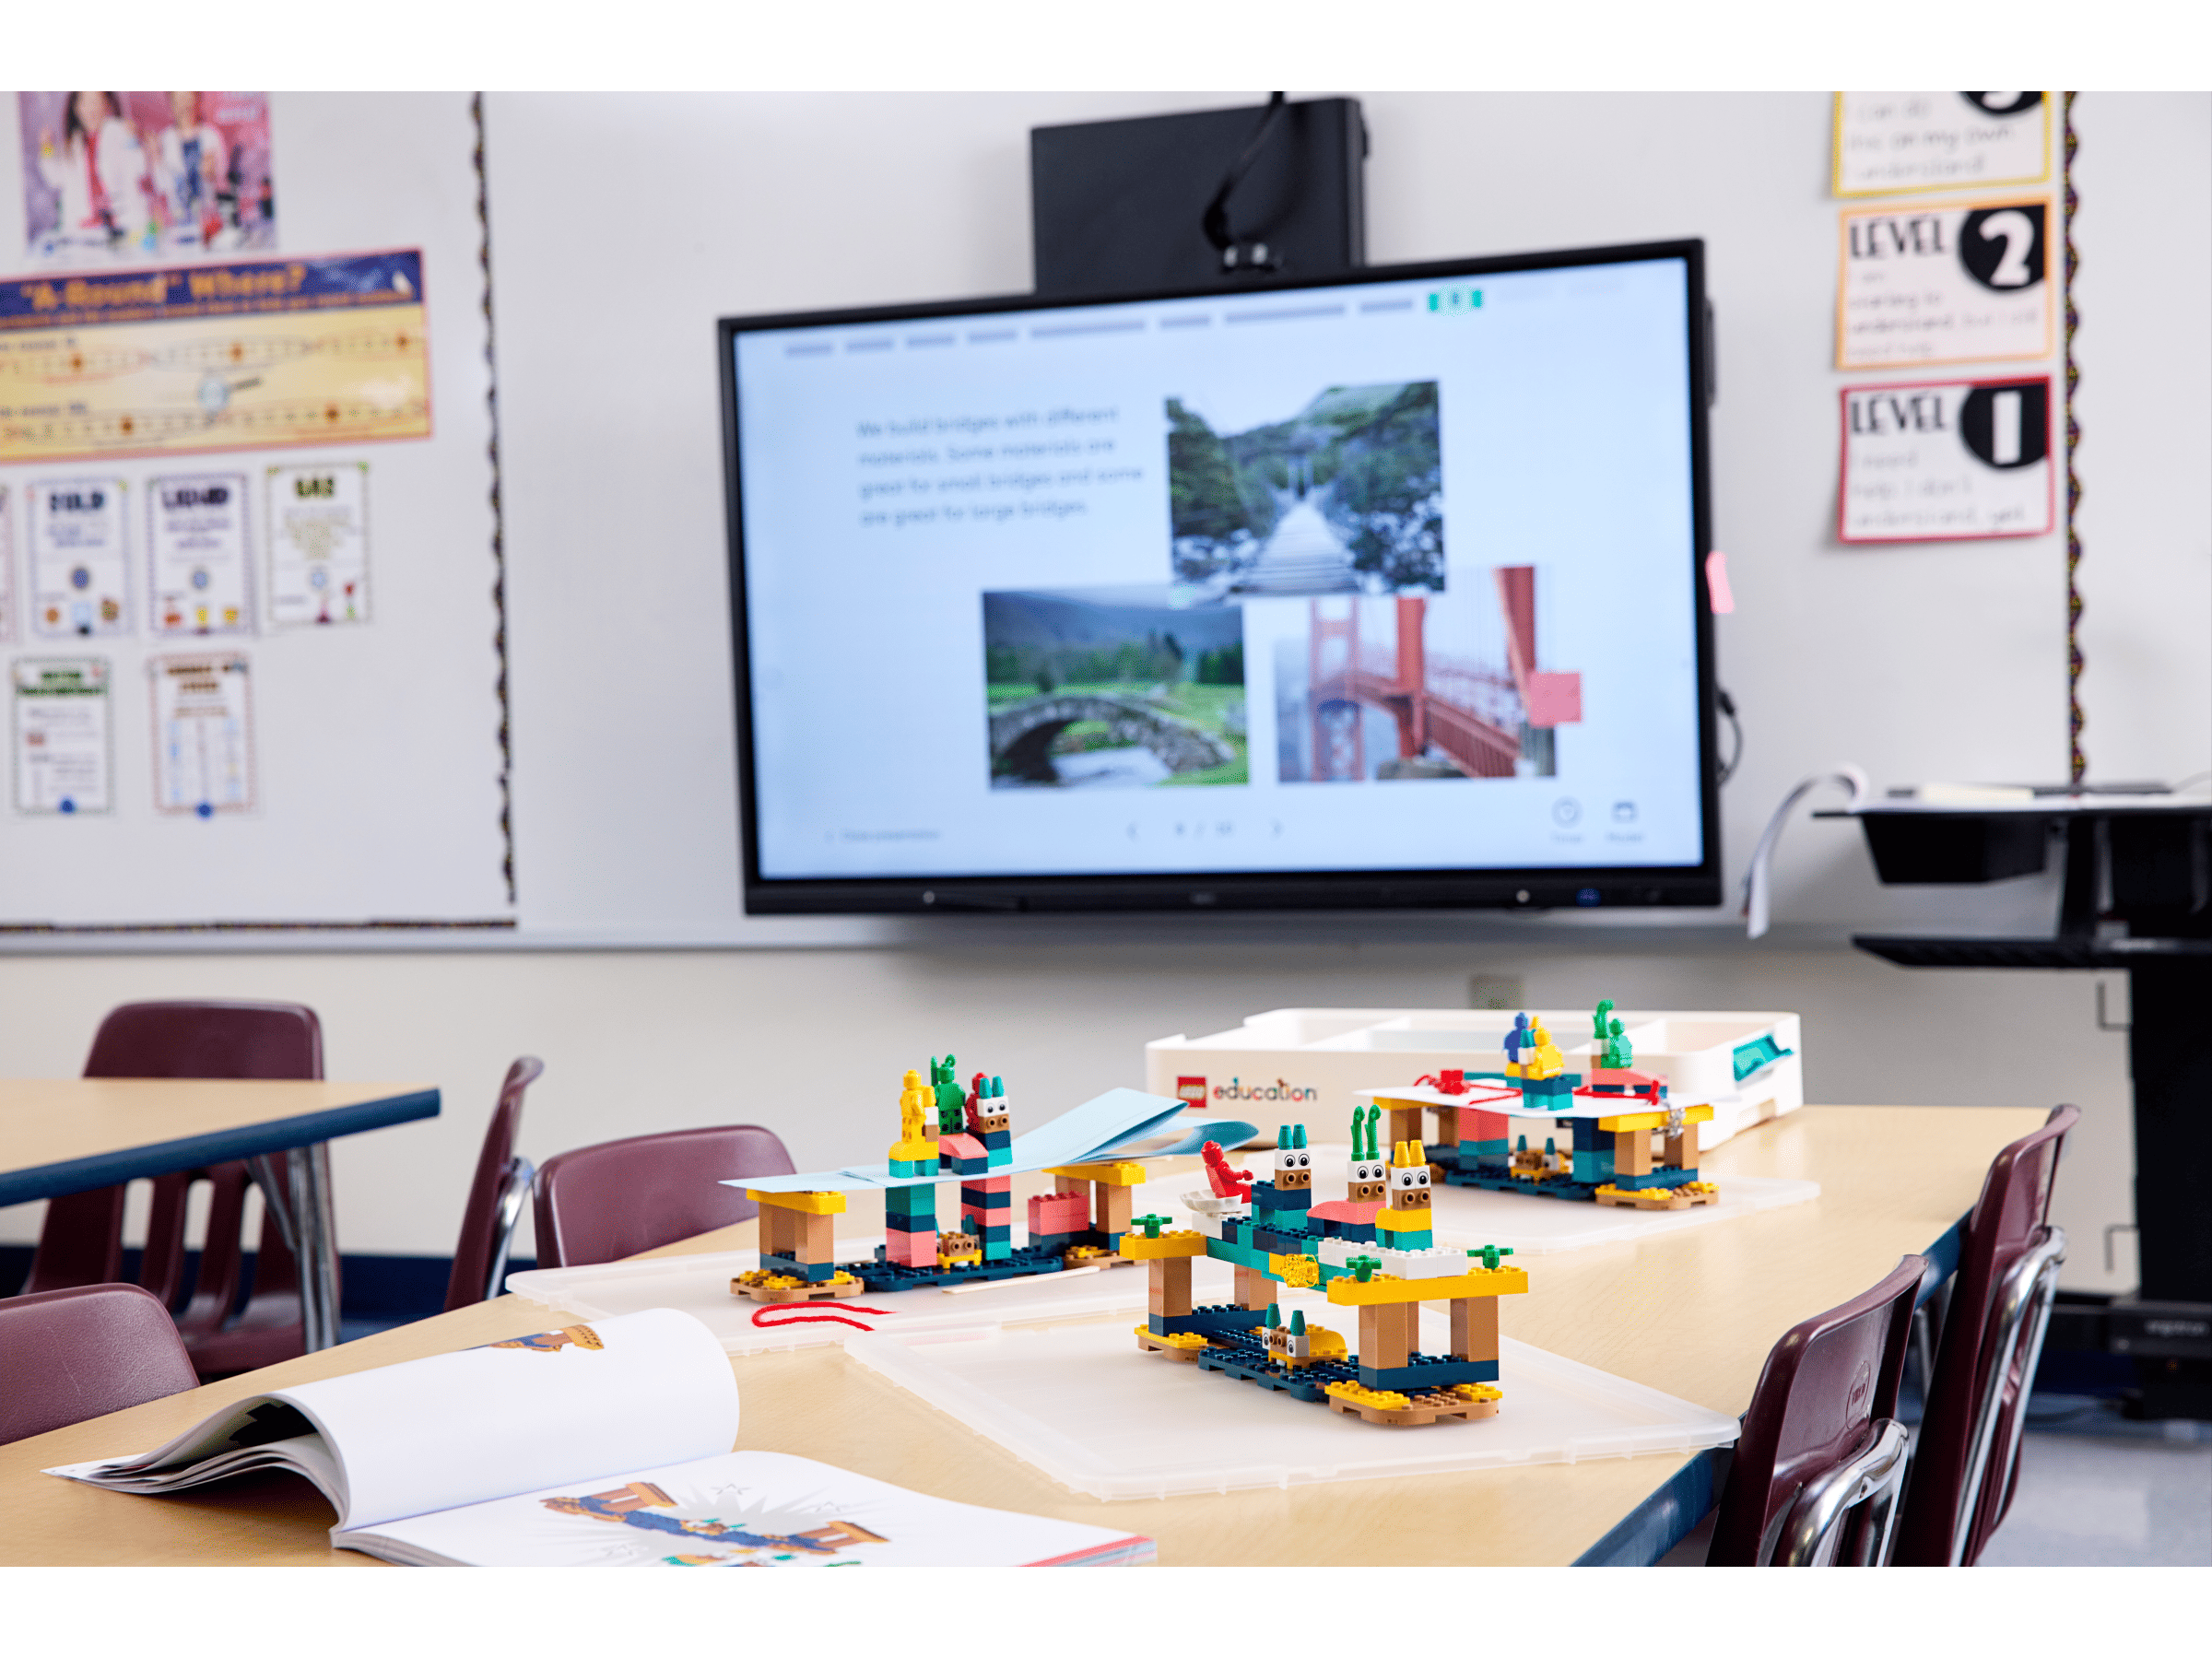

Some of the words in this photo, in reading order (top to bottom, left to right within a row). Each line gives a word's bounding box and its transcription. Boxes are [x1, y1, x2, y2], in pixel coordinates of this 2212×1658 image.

[1848, 214, 1952, 259] LEVEL
[1980, 210, 2033, 286] 2
[888, 418, 929, 436] build
[935, 416, 997, 437] bridges
[1004, 411, 1039, 429] with
[1047, 406, 1118, 427] different
[1851, 391, 1952, 435] LEVEL
[1993, 391, 2021, 464] 1
[946, 445, 994, 463] Some
[1001, 440, 1080, 459] materials
[1087, 441, 1115, 454] are
[859, 481, 901, 501] great
[909, 476, 930, 492] for
[936, 473, 982, 490] small
[988, 471, 1052, 493] bridges
[1058, 467, 1090, 483] and
[1097, 469, 1144, 483] some
[859, 512, 887, 528] are
[894, 509, 935, 531] great
[942, 505, 964, 520] for
[971, 504, 1014, 525] large
[1213, 1077, 1317, 1101] education
